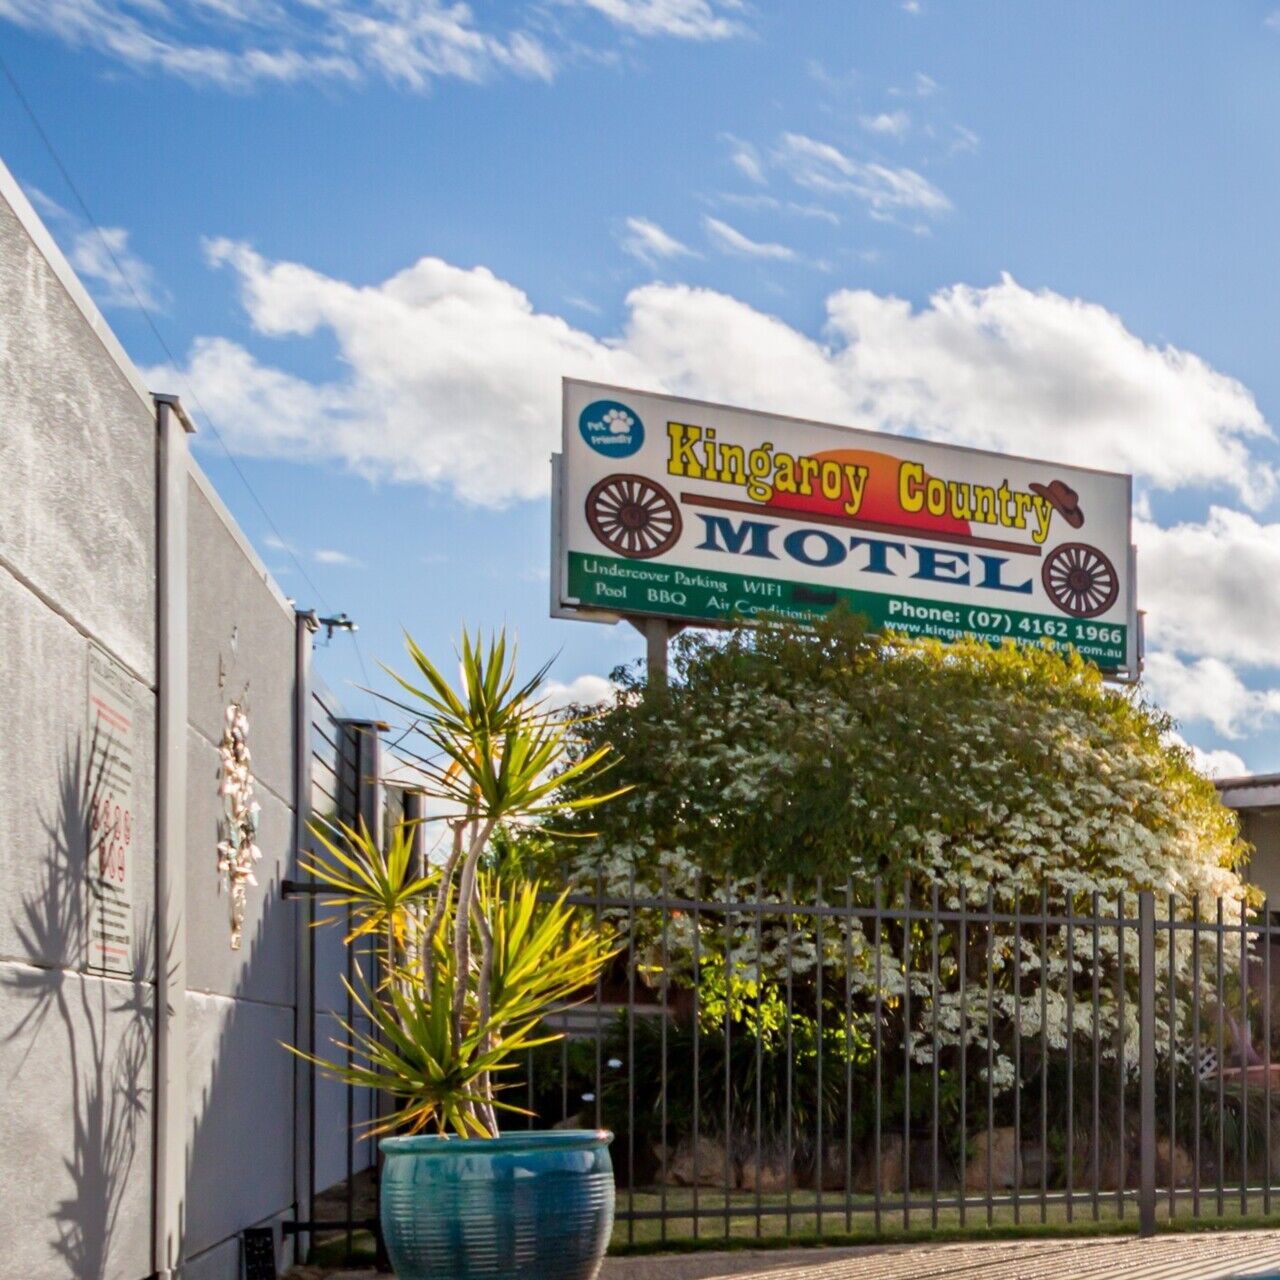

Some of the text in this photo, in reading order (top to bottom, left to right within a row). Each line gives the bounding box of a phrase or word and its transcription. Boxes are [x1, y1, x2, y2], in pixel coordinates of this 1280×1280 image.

[667, 421, 1053, 544] Kingaroy Country
[694, 513, 1033, 594] MOTEL
[583, 560, 782, 597] Undercover Parking WIFI
[596, 582, 627, 598] Pool
[647, 589, 687, 606] BBQ
[706, 595, 730, 611] Air
[888, 599, 1122, 643] Phone: (07) 4162 1966
